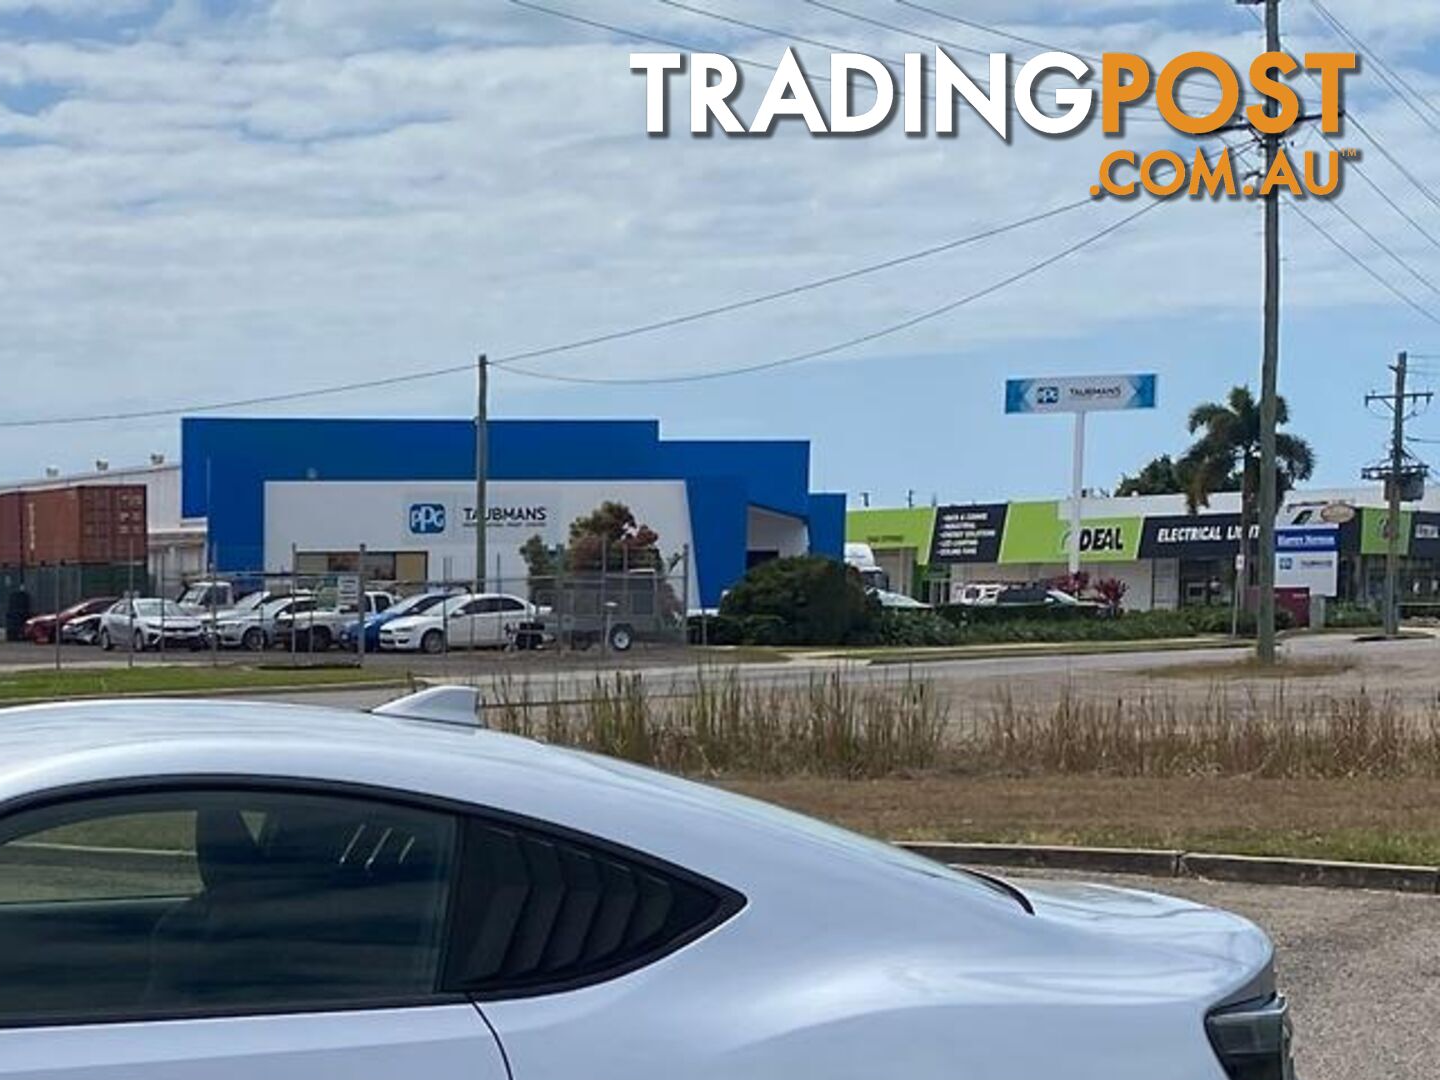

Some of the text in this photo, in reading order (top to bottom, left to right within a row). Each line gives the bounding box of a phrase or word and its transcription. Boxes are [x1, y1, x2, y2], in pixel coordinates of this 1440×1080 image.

[410, 505, 445, 532] PPG
[1079, 526, 1124, 551] DEAL
[1157, 525, 1221, 543] ELECTRICAL
